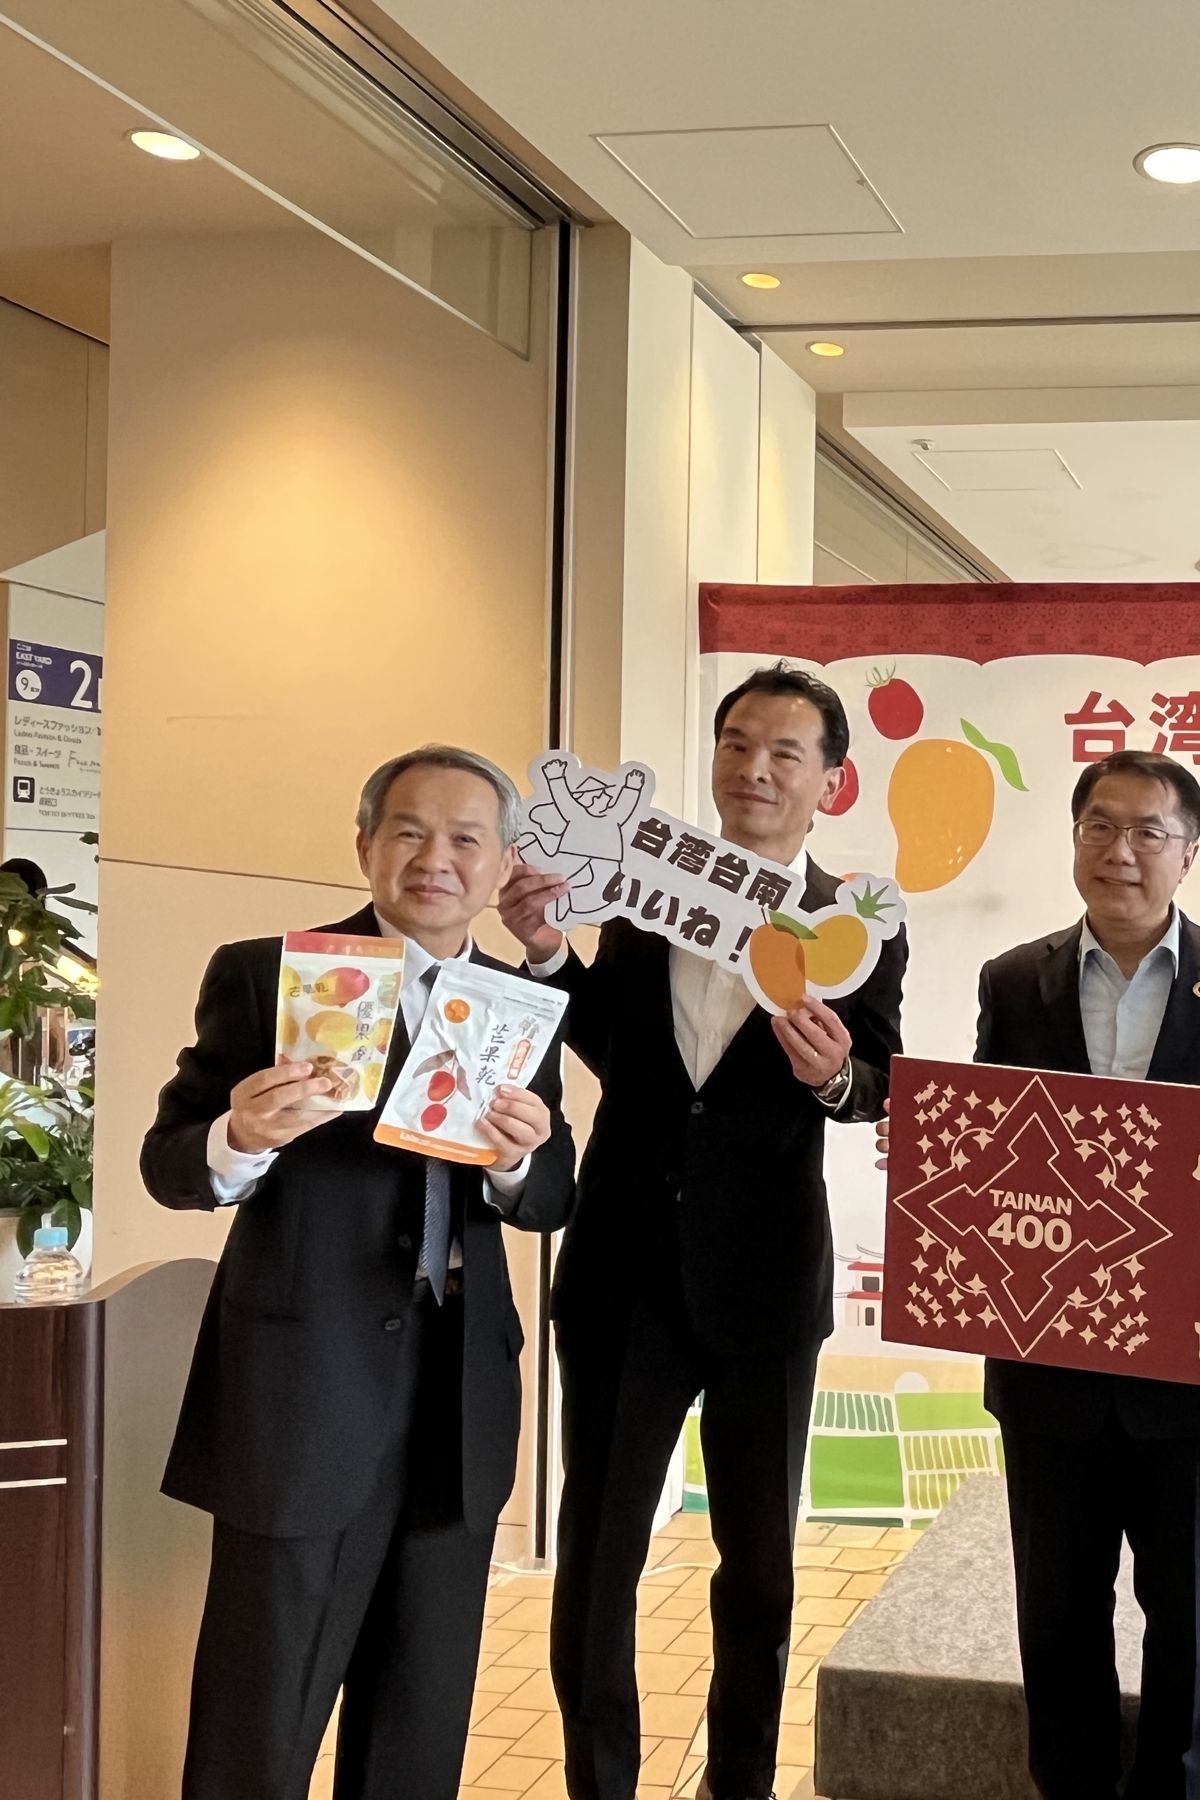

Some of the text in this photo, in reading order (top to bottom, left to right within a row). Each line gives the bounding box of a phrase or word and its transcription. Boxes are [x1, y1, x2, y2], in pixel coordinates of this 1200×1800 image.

[70, 659, 101, 709] 2
[630, 817, 792, 910] 台湾台南
[989, 1189, 1072, 1216] TAINAN
[987, 1212, 1072, 1253] 400
